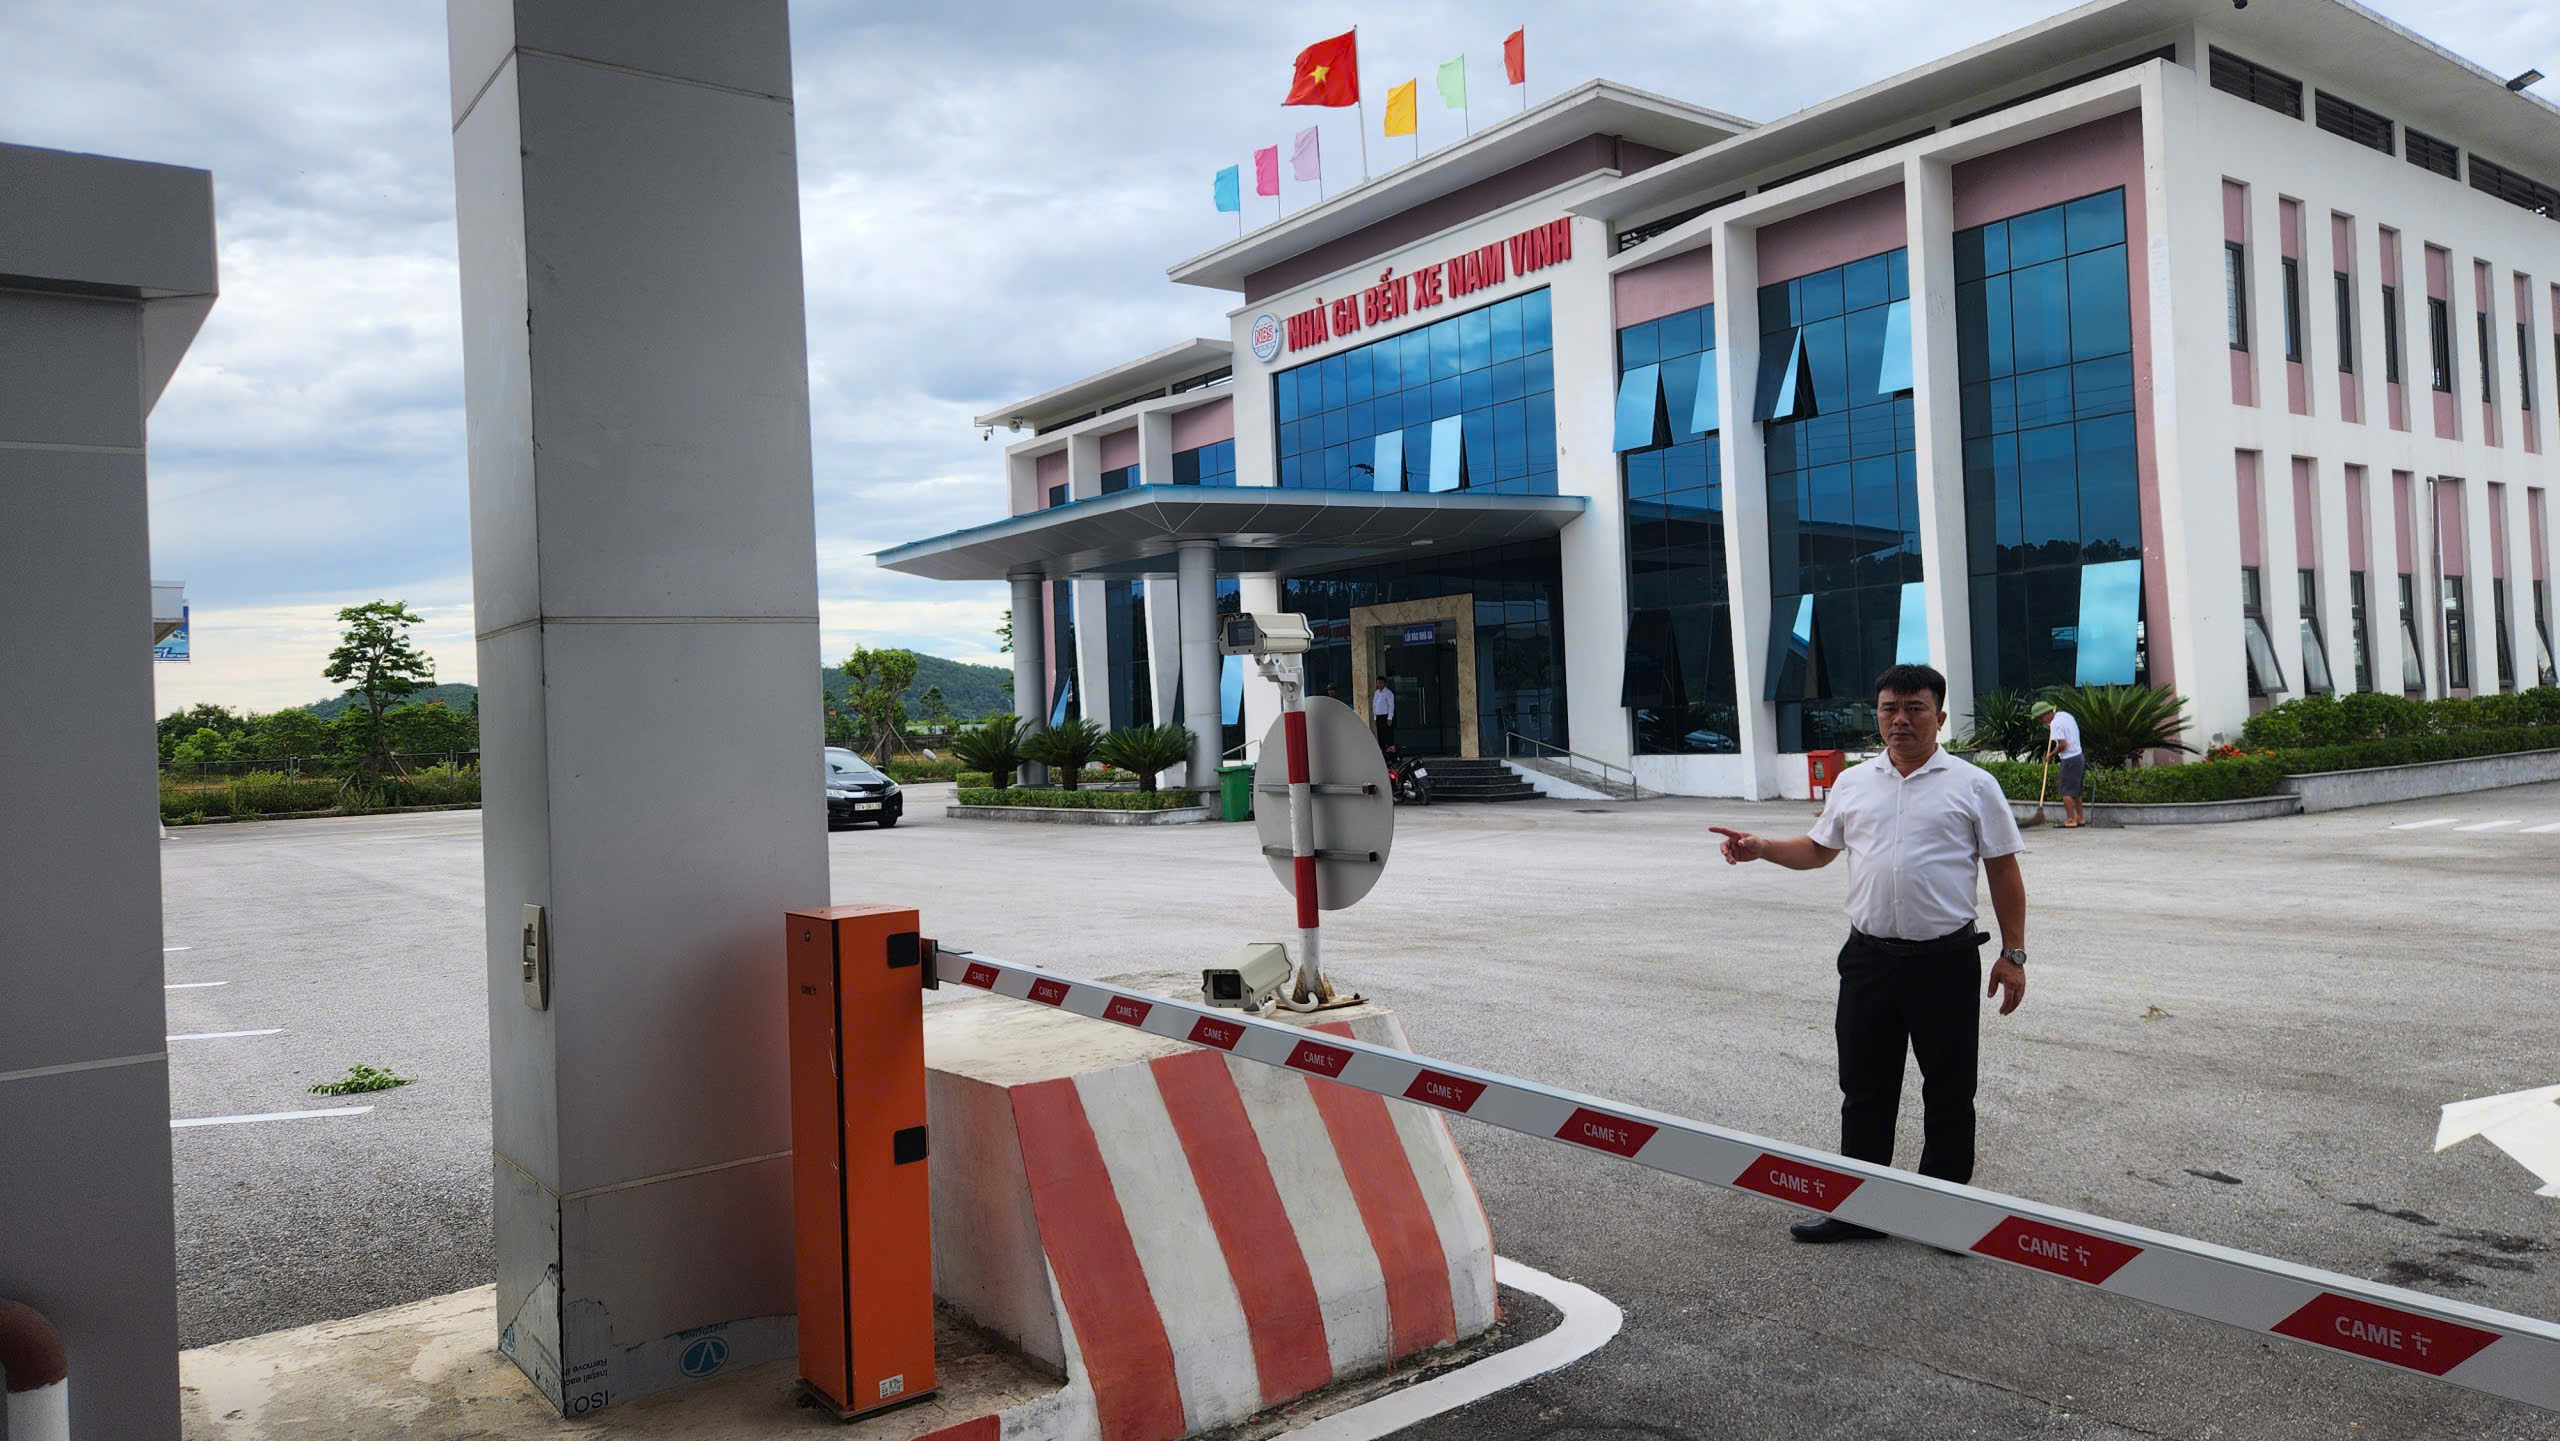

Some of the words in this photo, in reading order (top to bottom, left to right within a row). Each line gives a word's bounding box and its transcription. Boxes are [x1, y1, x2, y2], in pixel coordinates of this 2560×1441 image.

[1287, 297, 1328, 352] NHÀ
[1332, 294, 1360, 338] GA
[1364, 267, 1408, 327] BẾN
[1413, 263, 1443, 311] XE
[1447, 240, 1506, 299] NAM
[1508, 216, 1572, 276] VINH
[1254, 324, 1274, 346] NBS
[971, 970, 986, 983] CAME
[1038, 985, 1055, 998] CAME
[1115, 1004, 1133, 1018] CAME
[1203, 1026, 1223, 1041] CAME
[1303, 1051, 1325, 1067] CAME
[1426, 1081, 1452, 1100] CAME
[1583, 1122, 1615, 1143] CAME
[1769, 1169, 1809, 1194] CAME
[2017, 1233, 2069, 1263] CAME
[2334, 1315, 2404, 1350] CAME
[573, 1359, 608, 1373] Remove
[583, 1369, 608, 1383] Install
[574, 1390, 609, 1413] ISO
